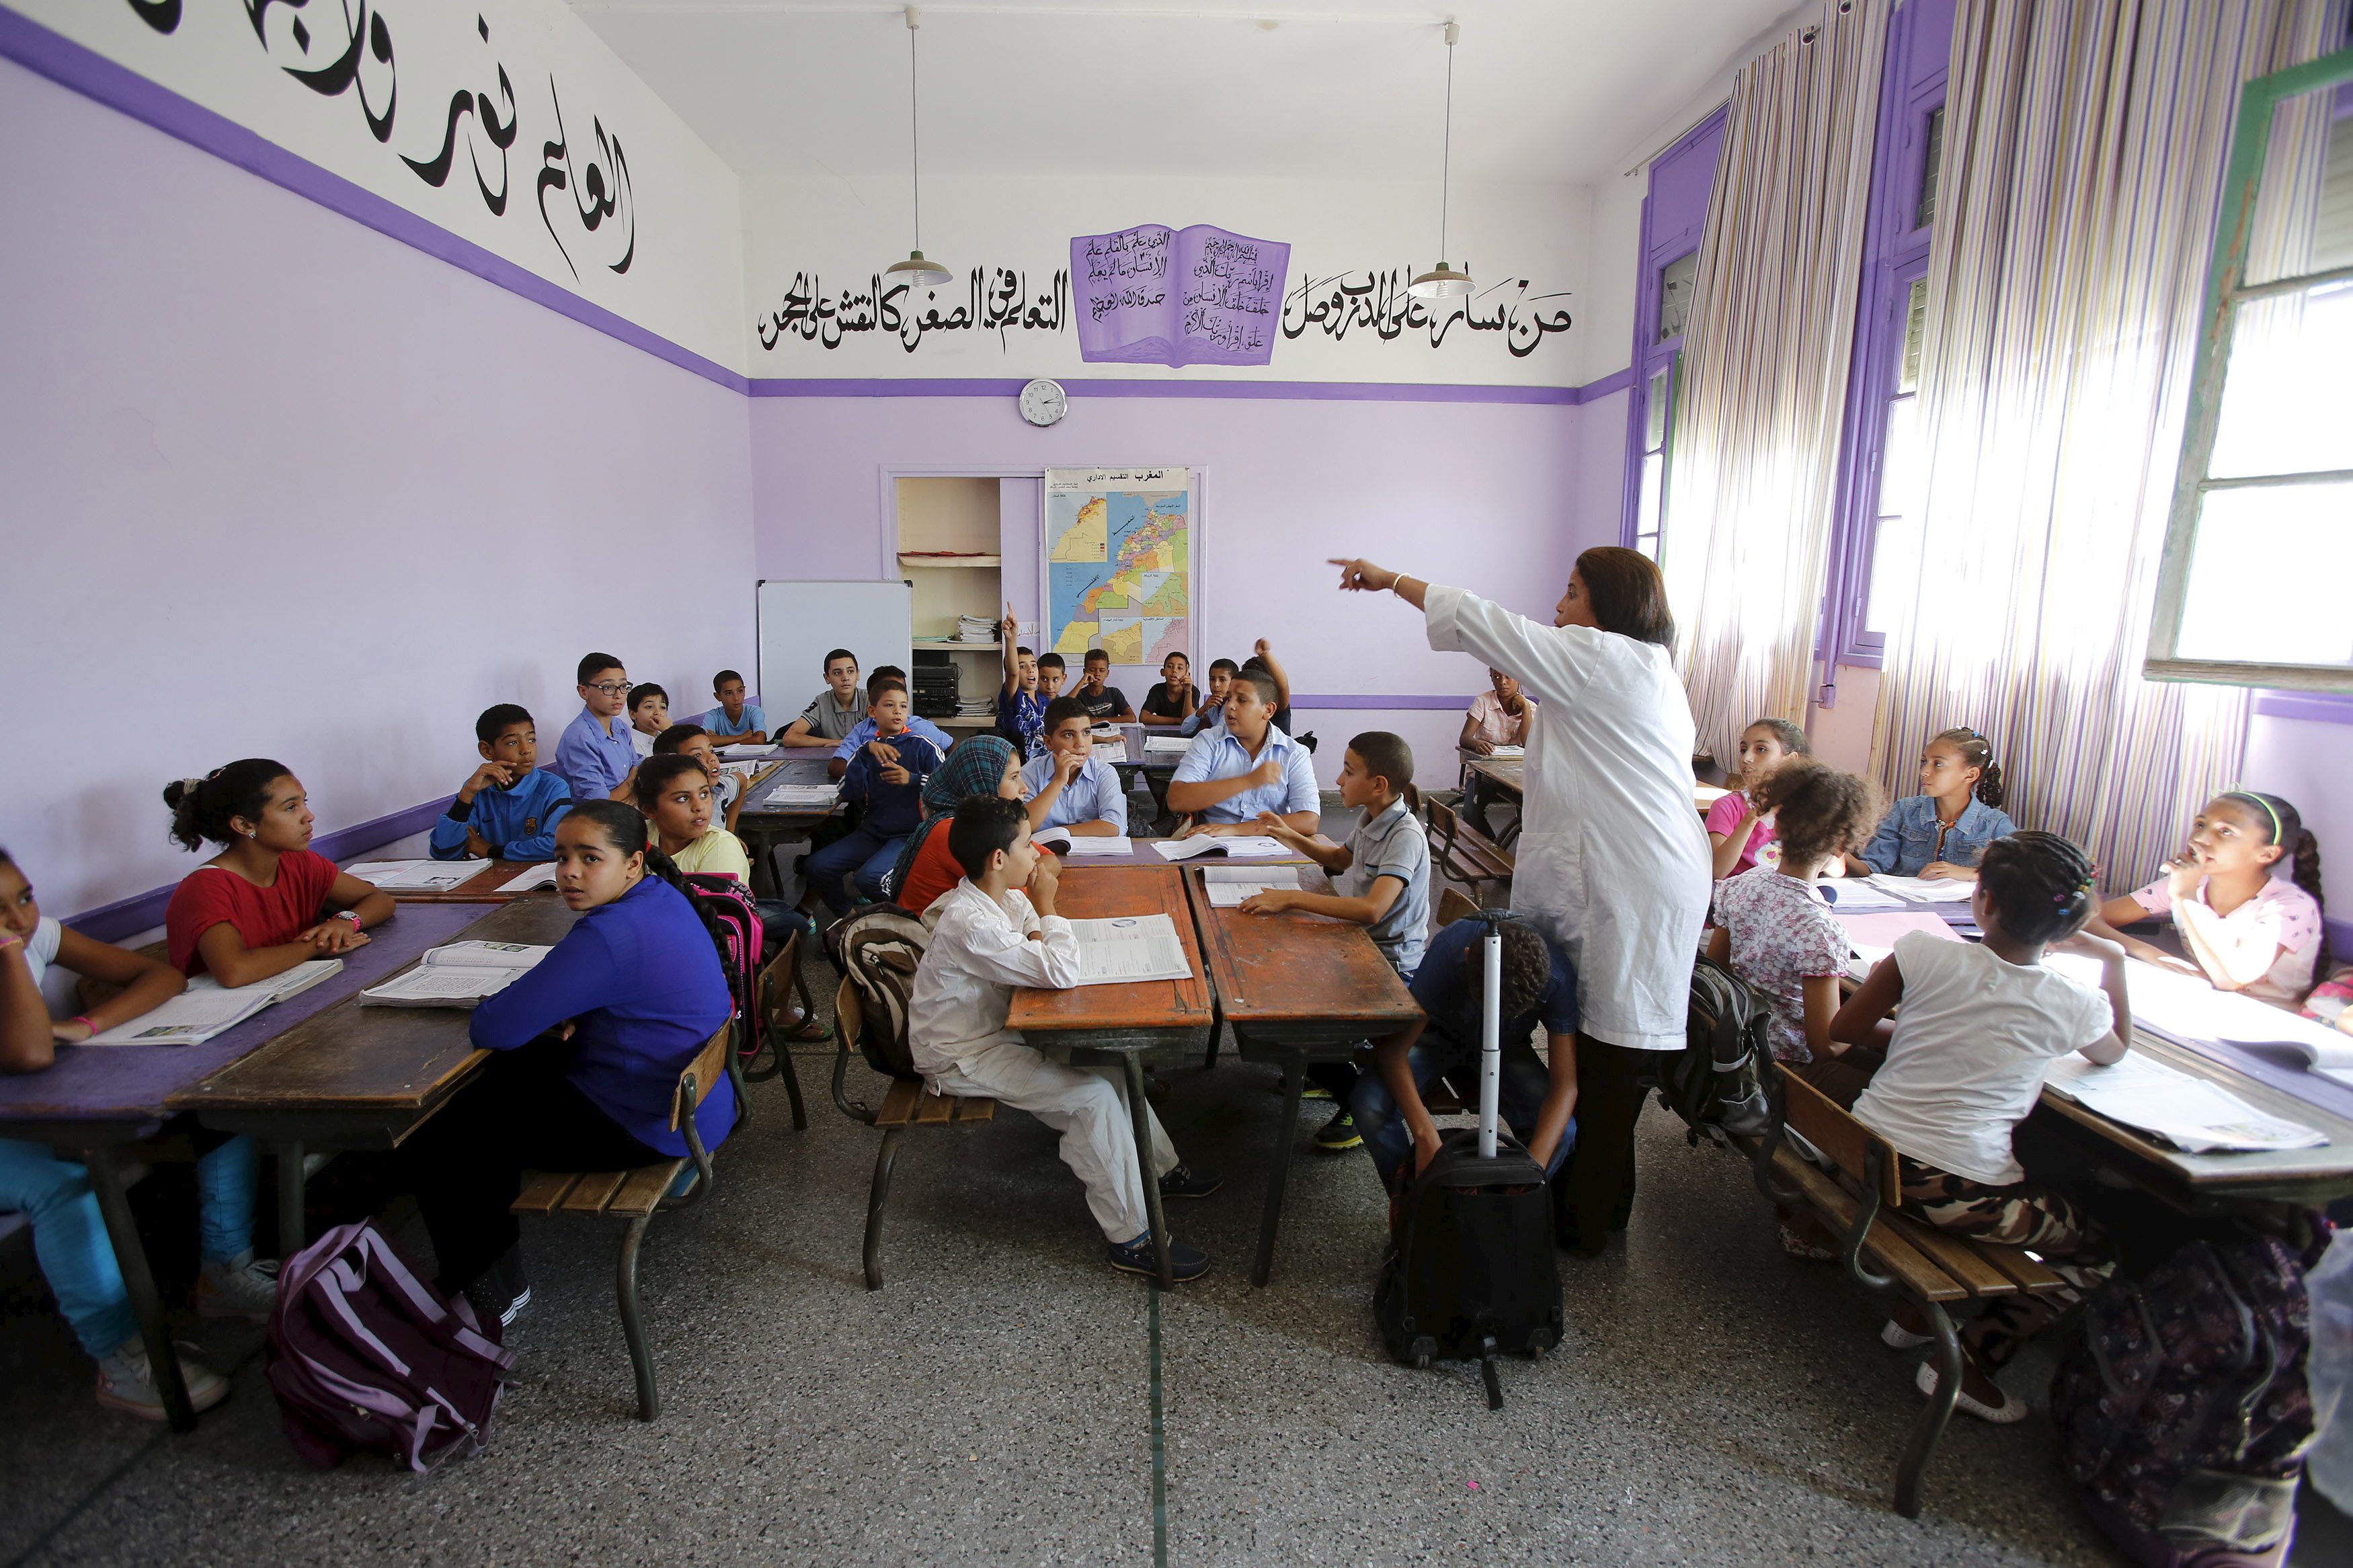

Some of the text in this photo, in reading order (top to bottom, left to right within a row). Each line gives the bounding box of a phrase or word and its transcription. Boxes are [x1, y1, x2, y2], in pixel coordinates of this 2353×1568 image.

[397, 11, 518, 217] نور
[537, 71, 634, 285] العلم
[758, 265, 1068, 355] التعلم في الصغر كالنقش على الحجر
[1135, 470, 1163, 481] المغرب
